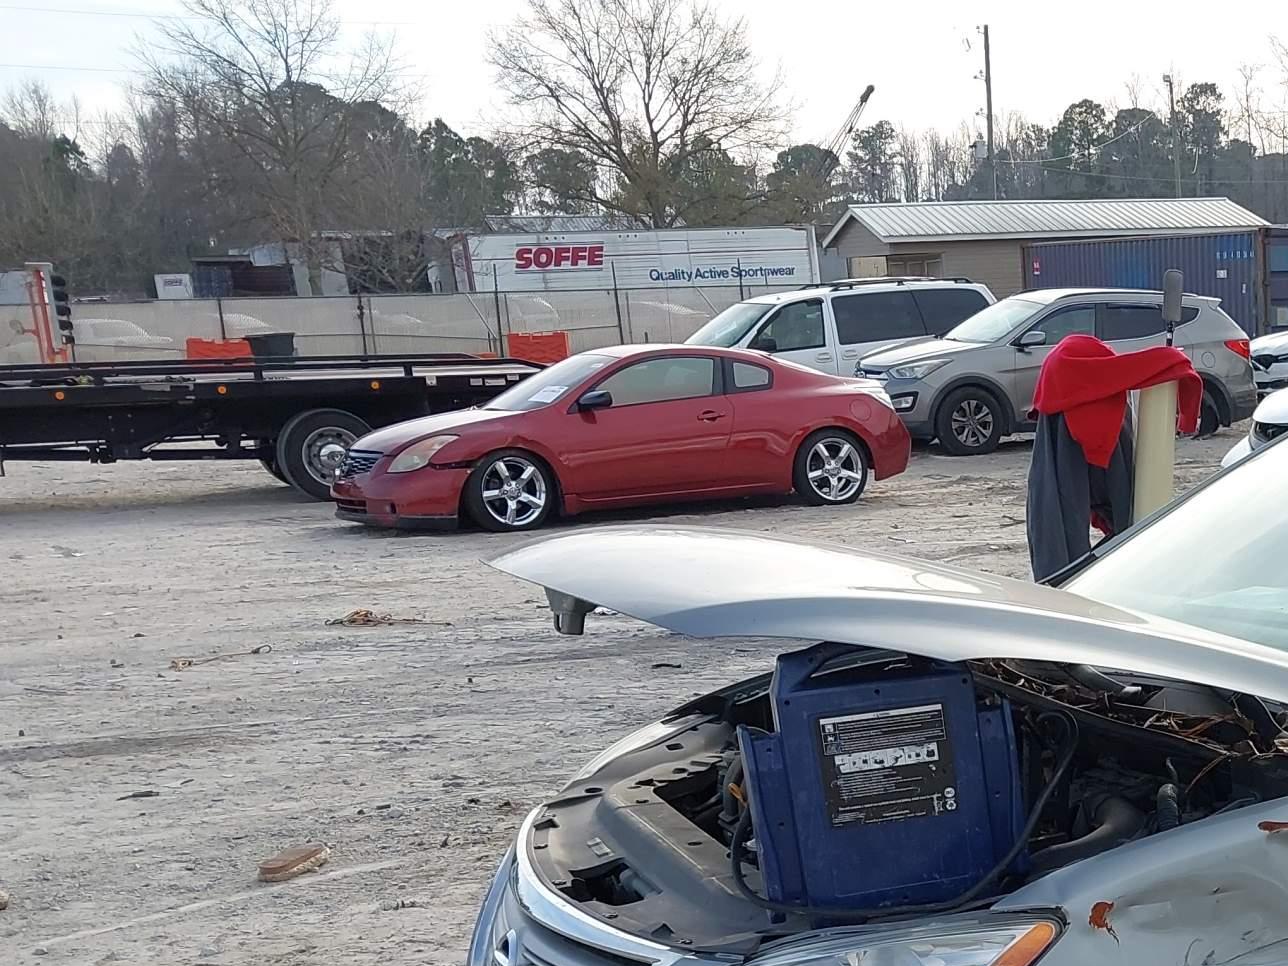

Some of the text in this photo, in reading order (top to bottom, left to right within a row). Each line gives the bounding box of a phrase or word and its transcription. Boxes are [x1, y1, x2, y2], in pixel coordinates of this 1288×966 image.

[515, 246, 604, 269] SOFFE
[649, 269, 693, 282] Quality
[694, 266, 729, 280] Active
